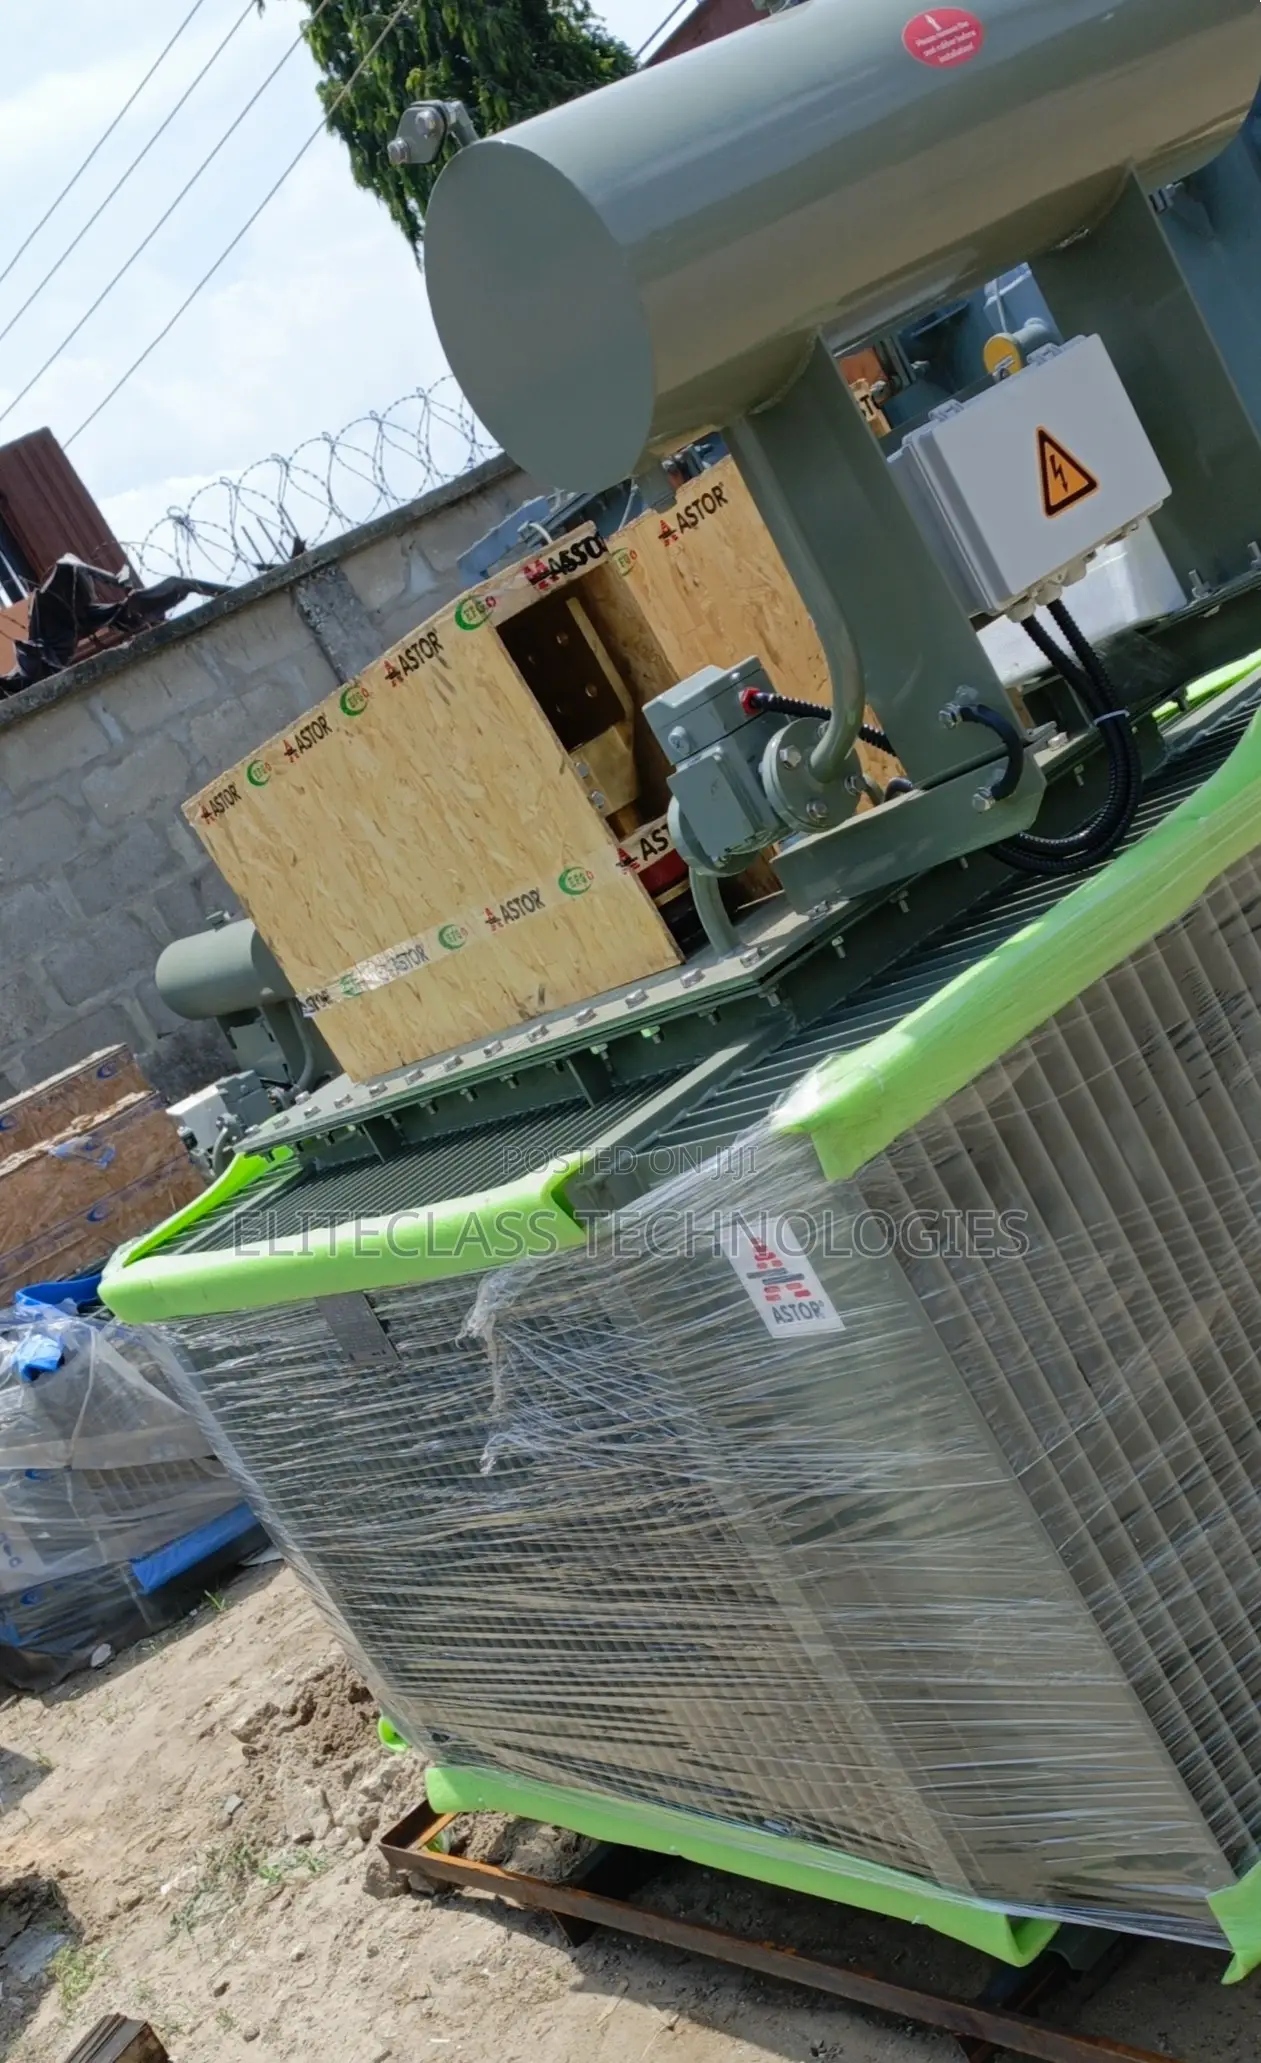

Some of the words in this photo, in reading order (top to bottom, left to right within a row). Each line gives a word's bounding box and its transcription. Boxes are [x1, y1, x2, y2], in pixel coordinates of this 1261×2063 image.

[676, 485, 728, 534] ASTOR
[208, 783, 242, 817] ASTOR
[294, 714, 333, 754] ASTOR
[397, 631, 444, 676] ASTOR
[499, 889, 546, 924] ASTOR
